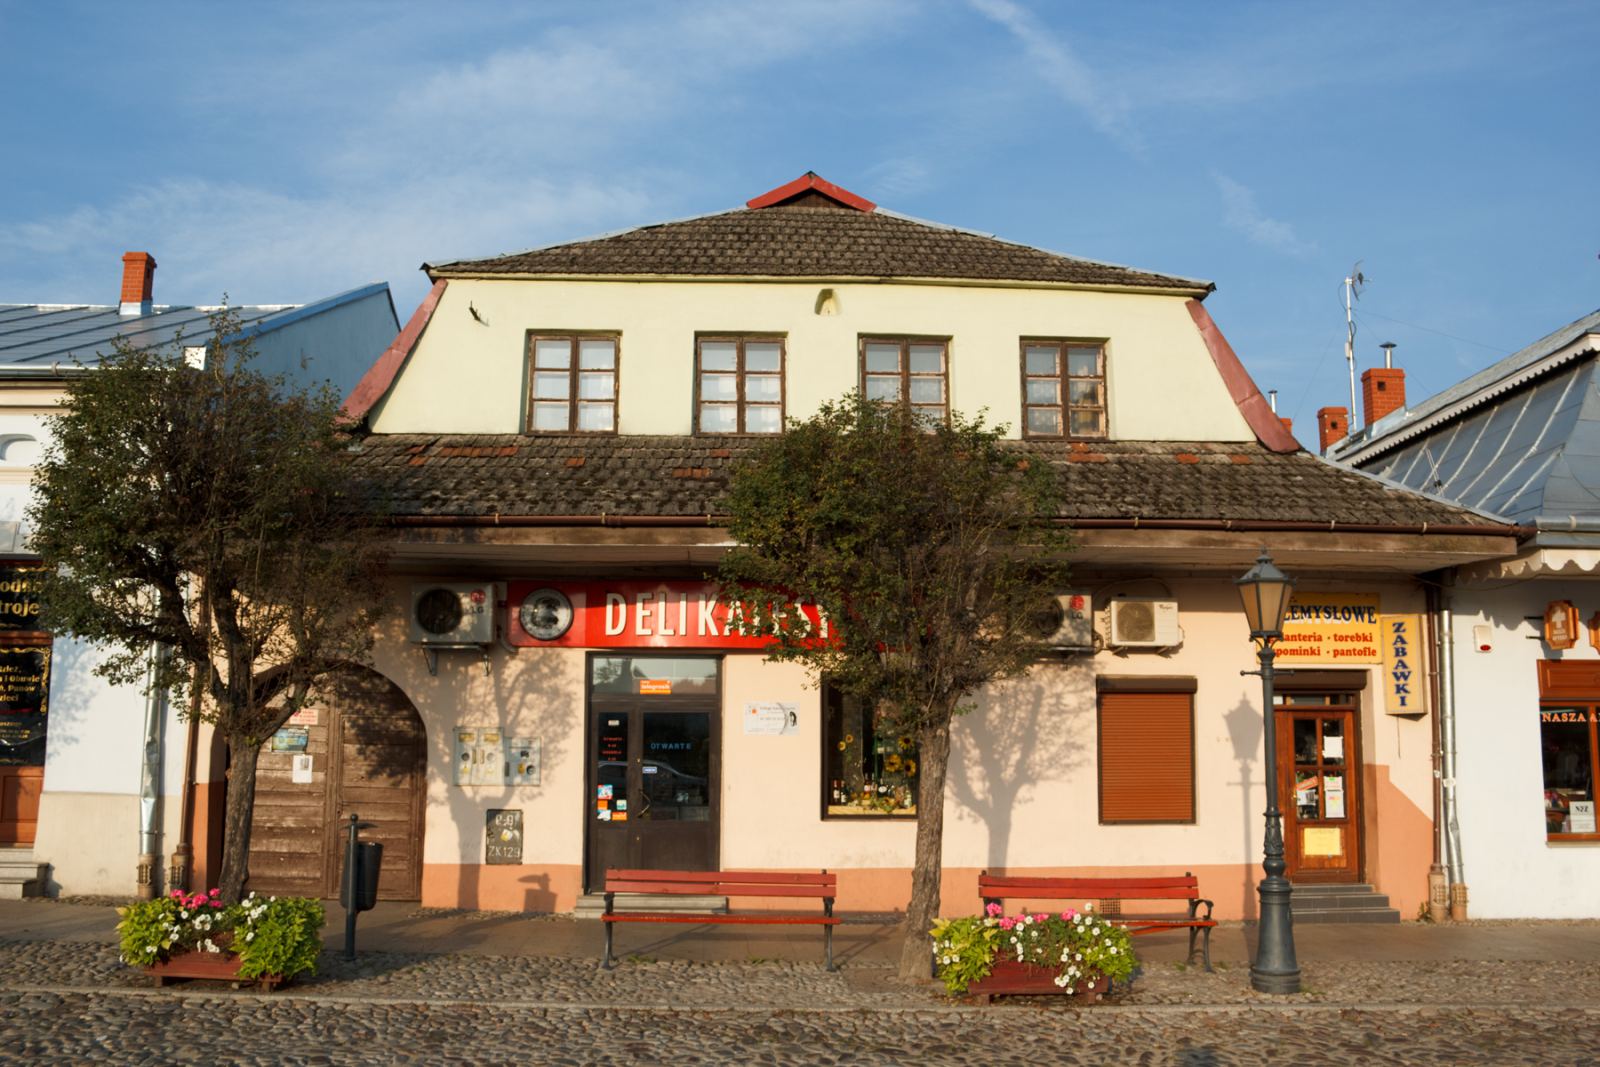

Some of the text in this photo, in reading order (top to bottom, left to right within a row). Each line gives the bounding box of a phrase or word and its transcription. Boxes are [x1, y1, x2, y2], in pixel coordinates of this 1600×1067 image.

[1071, 611, 1083, 619] LG
[1333, 632, 1373, 643] torebki
[1275, 646, 1377, 658] pominki pantofle
[1392, 622, 1411, 706] ZABAWKI
[1542, 713, 1587, 722] NASZA
